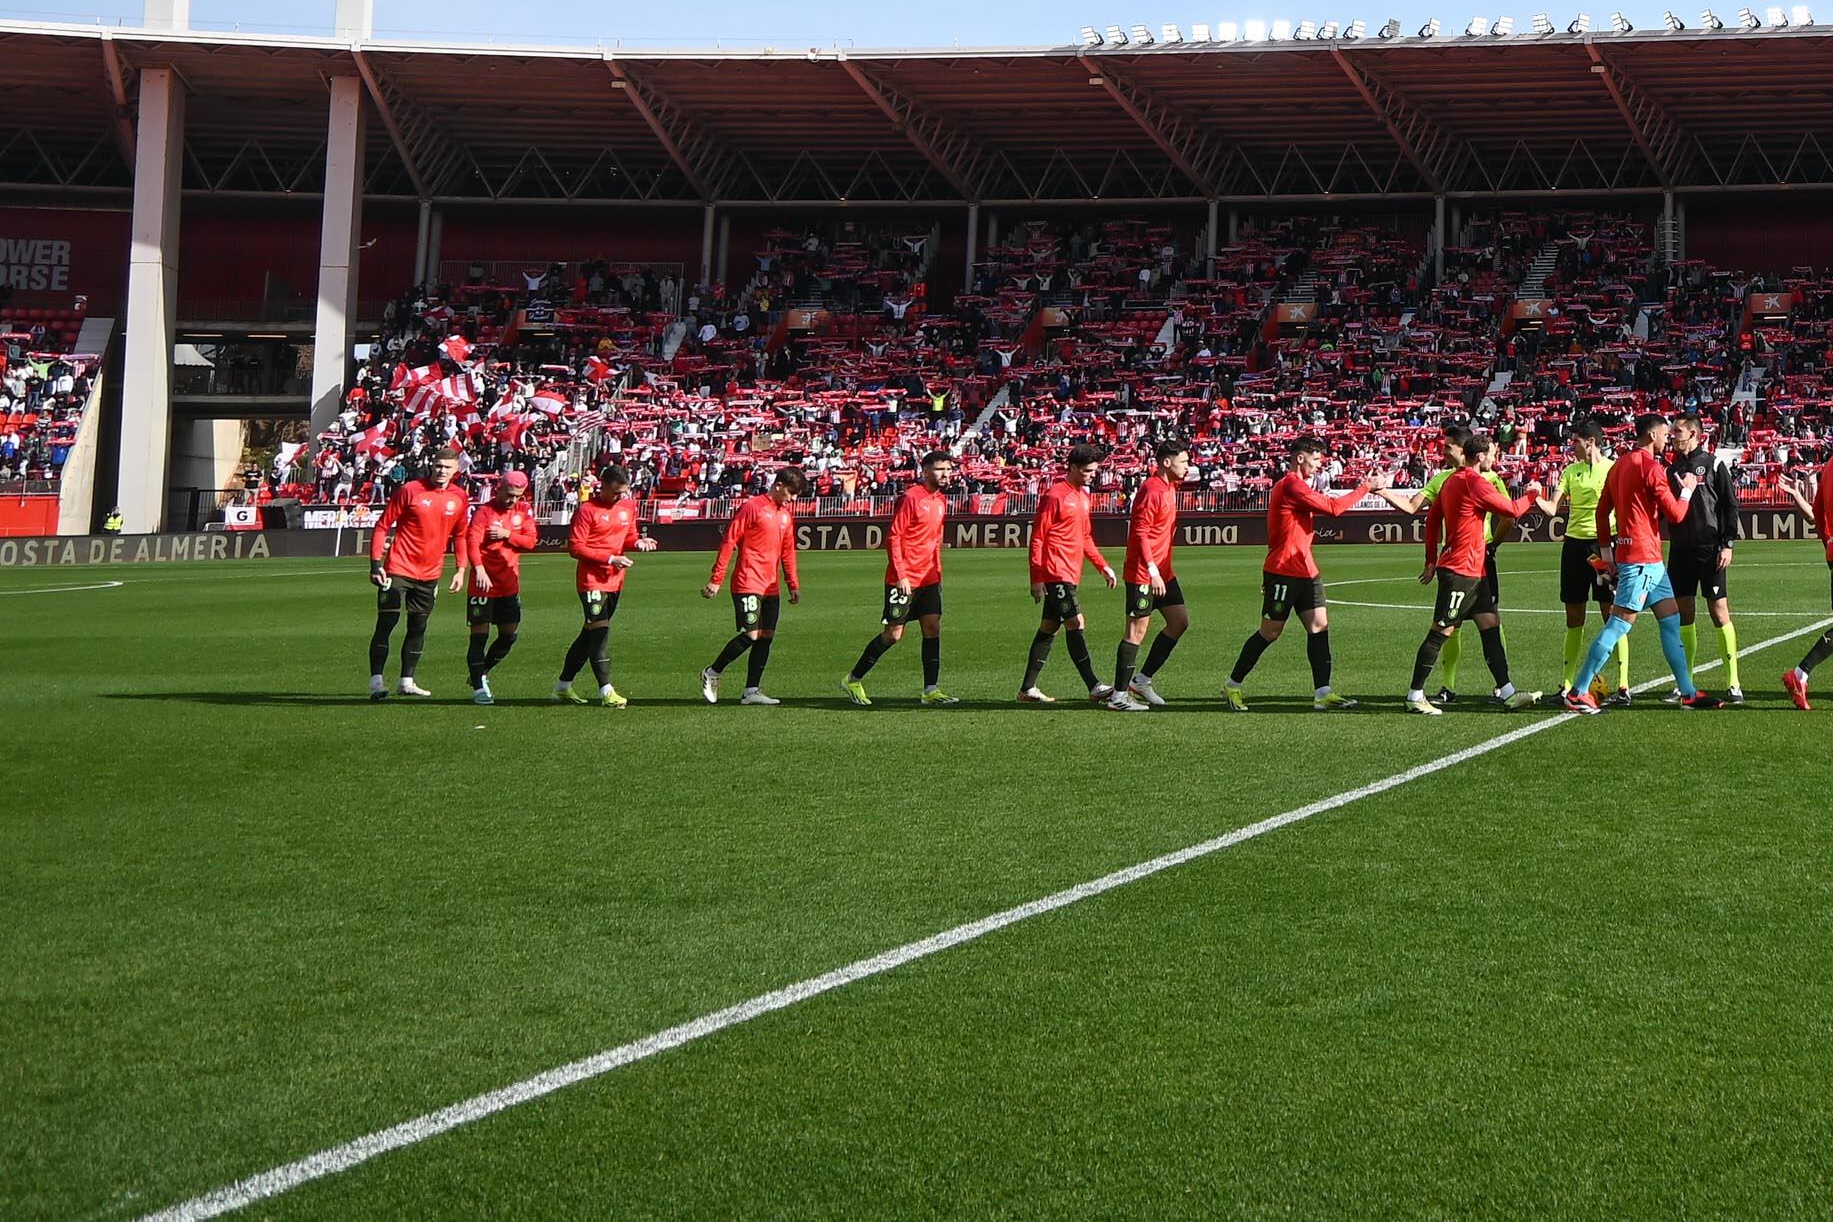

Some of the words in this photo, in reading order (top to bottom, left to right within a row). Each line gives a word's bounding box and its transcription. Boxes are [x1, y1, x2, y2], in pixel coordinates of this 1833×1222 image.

[236, 510, 248, 522] G
[1185, 524, 1239, 545] una
[1368, 522, 1403, 543] en
[89, 539, 124, 564] DE
[134, 531, 271, 563] ALMERÍA
[587, 590, 602, 604] 14
[1055, 584, 1066, 600] 3
[1273, 584, 1288, 602] 11
[1450, 591, 1465, 610] 17
[741, 595, 758, 613] 18
